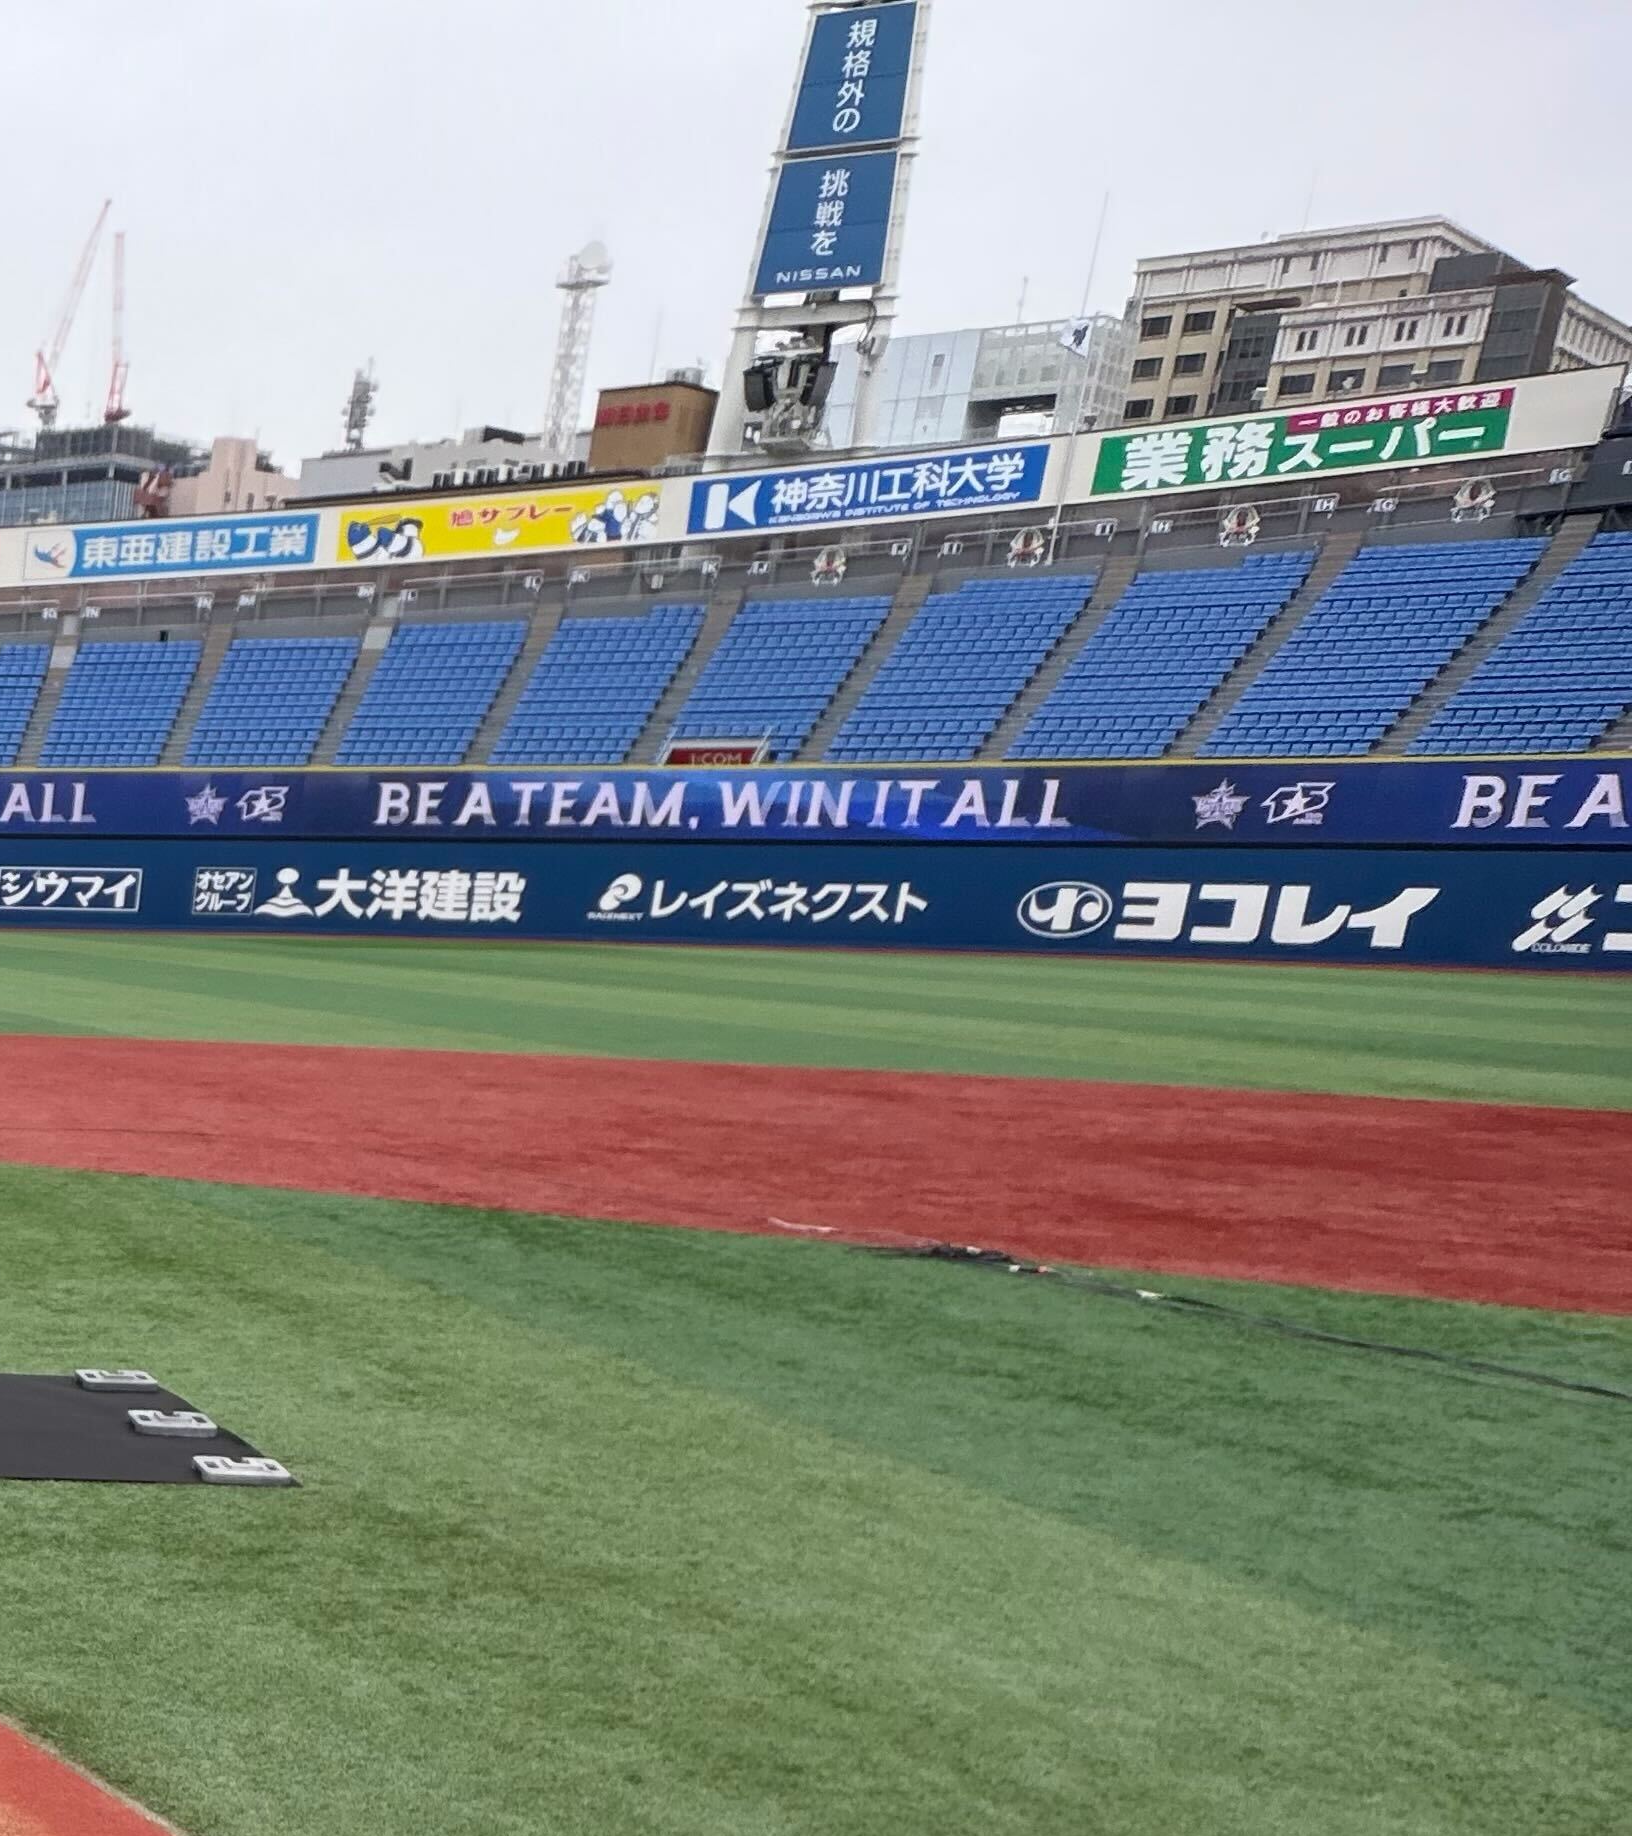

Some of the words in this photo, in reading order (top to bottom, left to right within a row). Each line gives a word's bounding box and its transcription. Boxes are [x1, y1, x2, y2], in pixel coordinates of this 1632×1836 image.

[832, 18, 878, 134] 規格外の
[810, 168, 851, 257] 挑戦を
[775, 265, 862, 284] NISSAN
[1121, 416, 1486, 490] 業務スーパー
[769, 452, 1025, 515] 神奈川工科大学
[83, 523, 309, 569] 東亜建設工業
[375, 783, 447, 824] BE
[454, 783, 495, 824] A
[512, 782, 697, 828] TEAM,
[720, 781, 855, 826] WIN
[871, 781, 937, 824] IT
[943, 780, 1072, 826] ALL
[1451, 775, 1562, 827] BE
[1558, 774, 1628, 827] A
[194, 892, 253, 912] グループ
[196, 870, 254, 891] オセアン
[315, 867, 527, 923] 大洋建設
[650, 878, 928, 923] レイズネクスト
[1112, 881, 1442, 950] ヨコレイ
